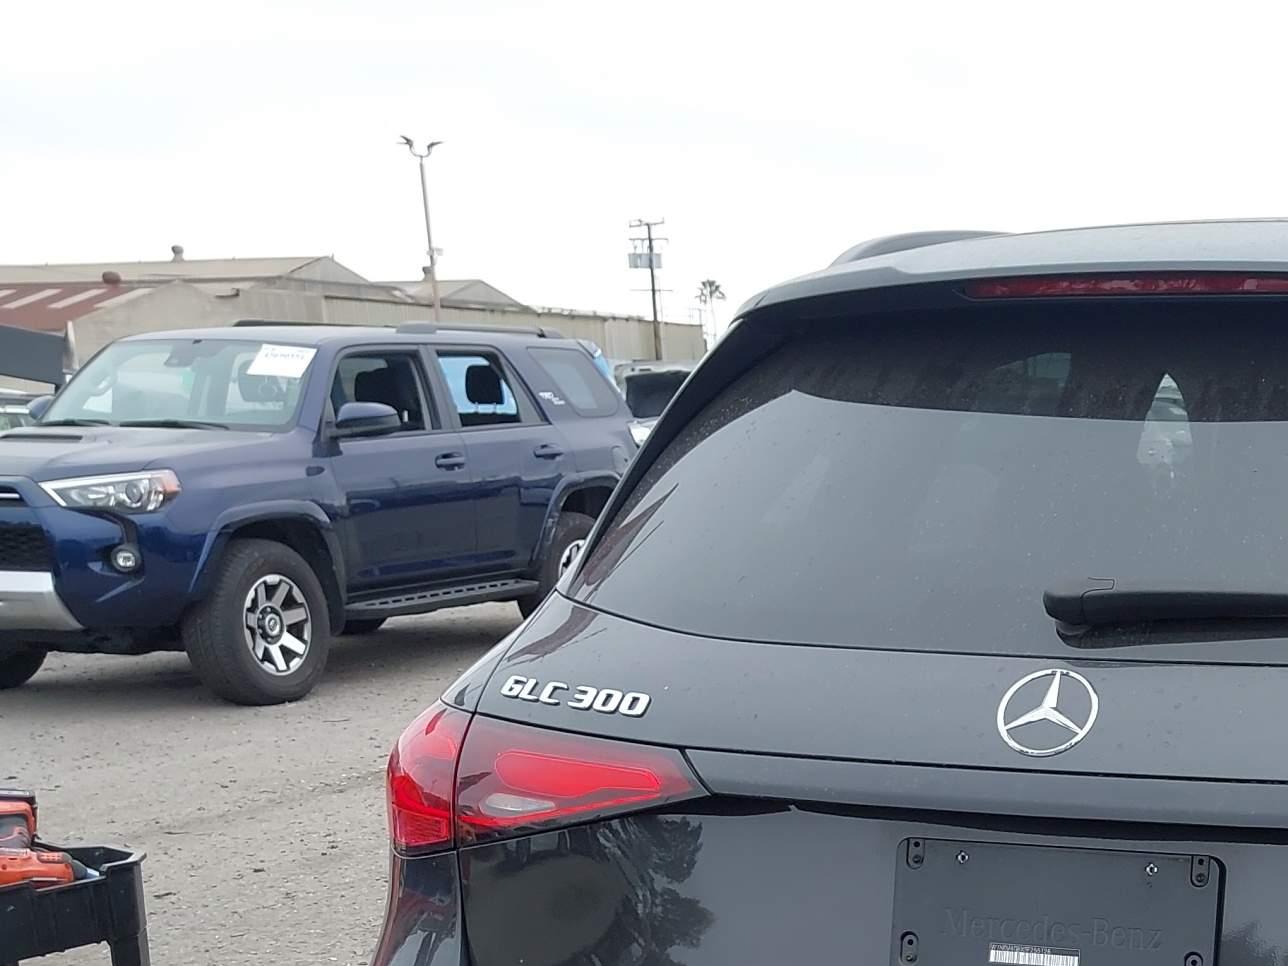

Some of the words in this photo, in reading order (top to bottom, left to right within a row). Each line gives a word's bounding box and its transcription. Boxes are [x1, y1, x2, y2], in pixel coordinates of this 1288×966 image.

[500, 675, 569, 706] GLC
[567, 685, 652, 718] 300
[943, 906, 1163, 951] Mercedes-Benz
